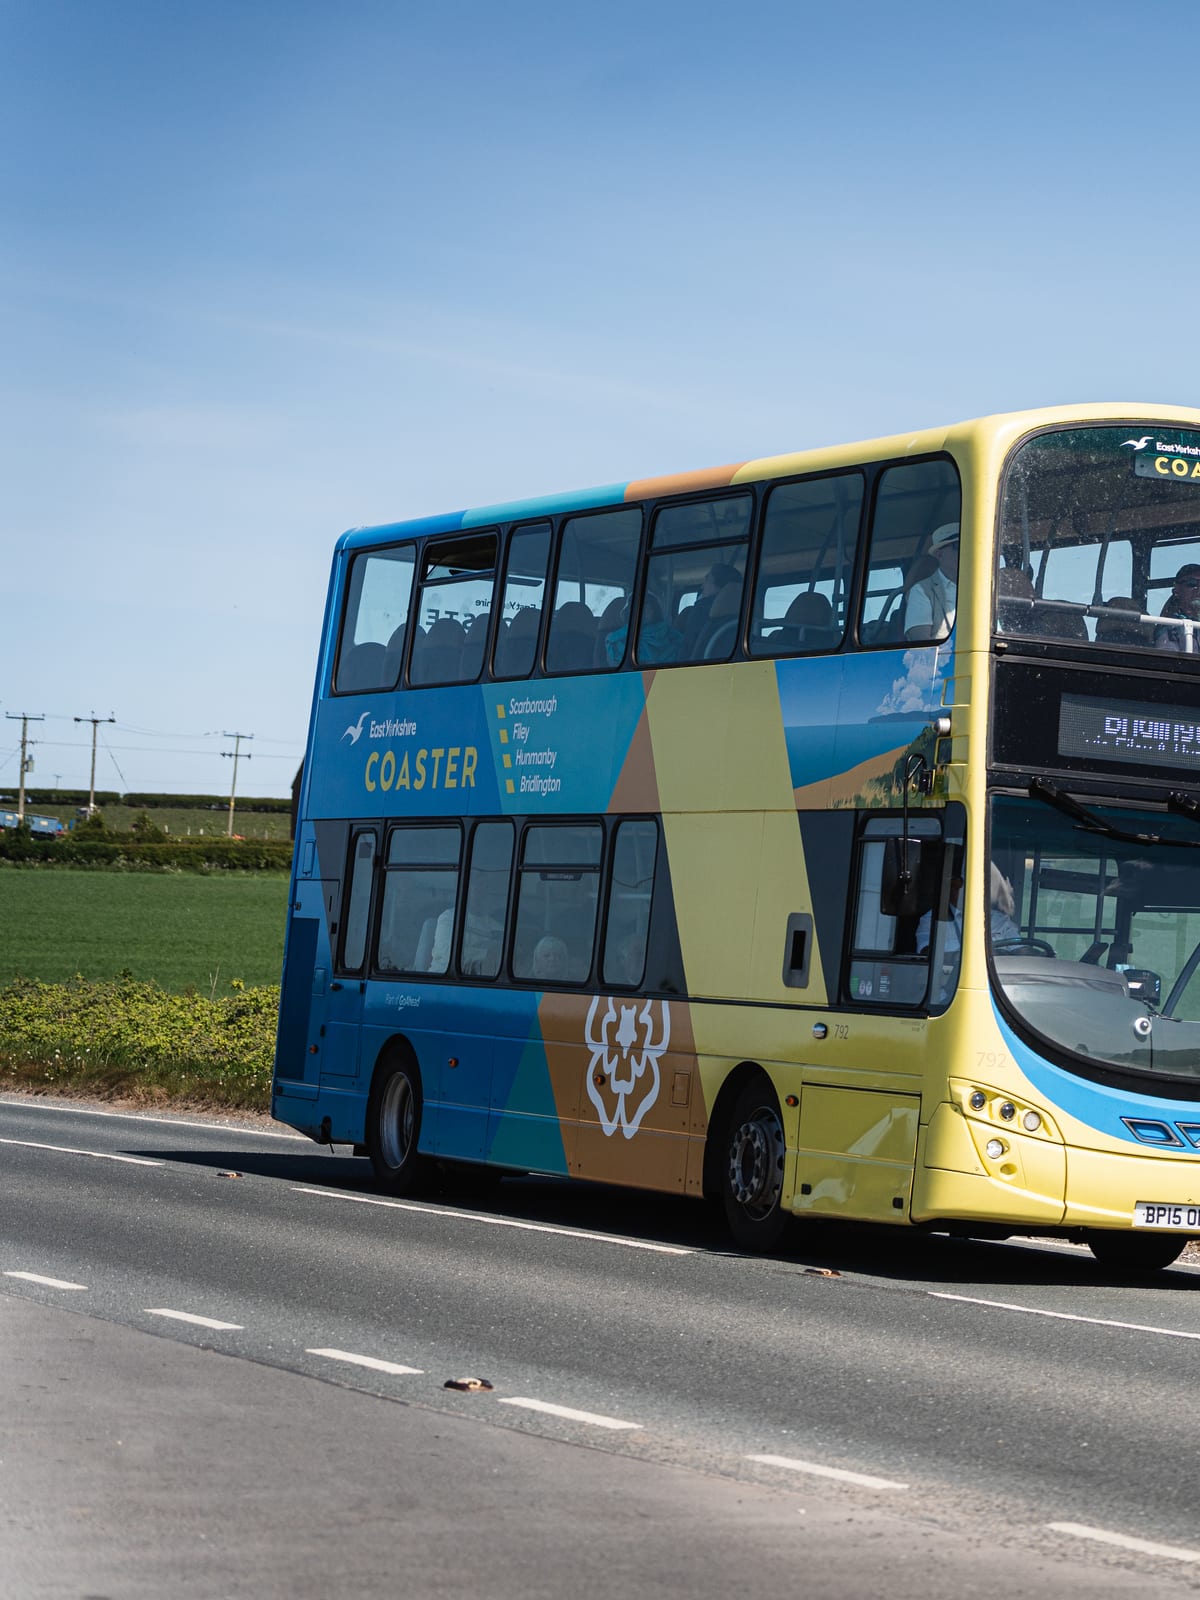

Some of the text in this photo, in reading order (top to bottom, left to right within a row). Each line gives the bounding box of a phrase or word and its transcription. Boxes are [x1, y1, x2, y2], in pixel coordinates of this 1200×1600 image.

[1156, 441, 1175, 453] East
[509, 695, 557, 717] Scarborough
[369, 718, 417, 738] East Yorkshire
[512, 722, 530, 744] Filey
[515, 747, 557, 769] Hunmanby
[364, 746, 478, 793] COASTER
[520, 775, 561, 797] Bridlington
[834, 1024, 849, 1040] 792
[975, 1051, 1008, 1069] 792
[1145, 1206, 1183, 1225] BP15
